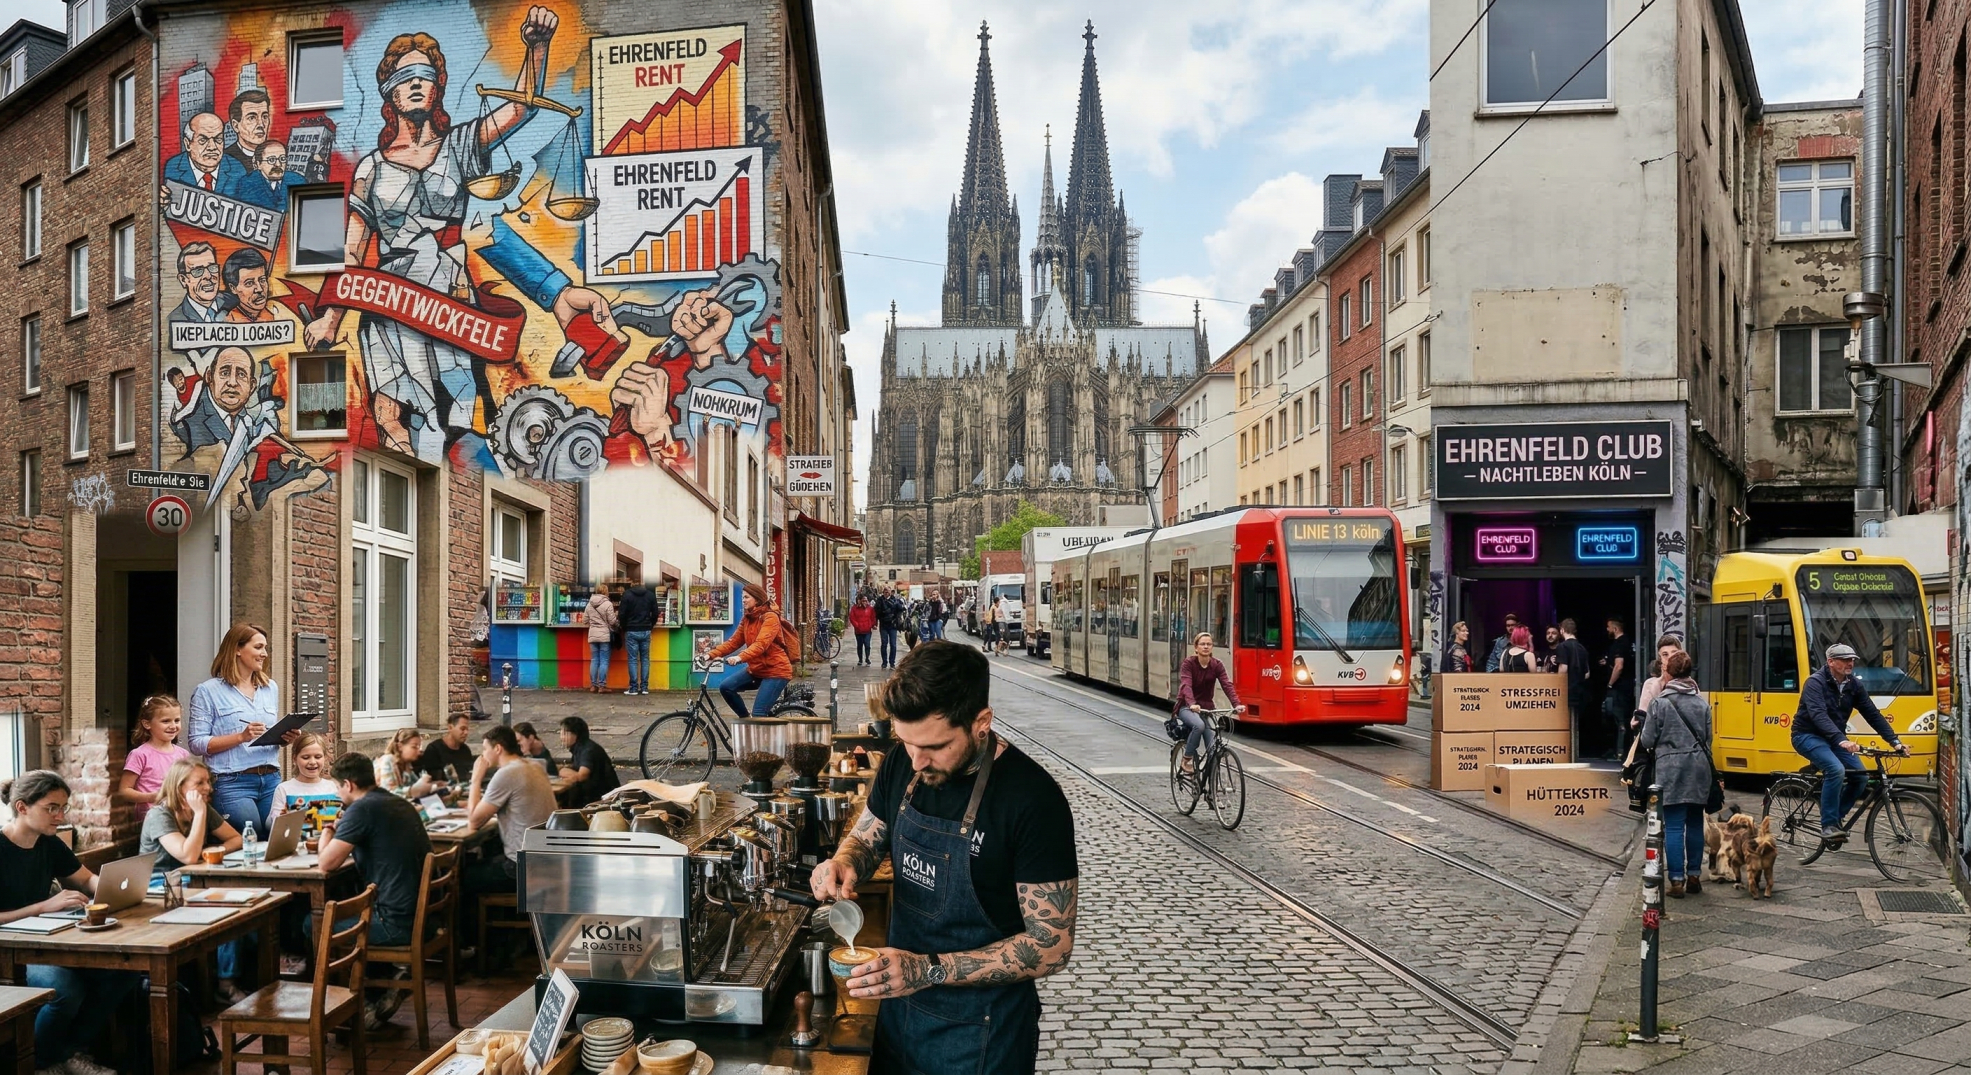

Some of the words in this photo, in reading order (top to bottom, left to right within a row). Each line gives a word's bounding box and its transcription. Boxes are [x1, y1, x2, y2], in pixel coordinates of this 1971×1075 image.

[609, 38, 707, 65] EHRENFELD
[635, 63, 686, 88] RENT
[614, 160, 717, 186] EHRENFELD
[637, 187, 685, 210] RENT
[170, 188, 273, 244] JUSTICE
[336, 273, 509, 353] GEGENTWICKFELE
[242, 324, 290, 340] LOGAIS?
[693, 392, 758, 419] NOHKRUM
[1445, 436, 1589, 464] EHRENFELD
[1597, 434, 1663, 460] CLUB
[1480, 465, 1584, 483] NACHTLEBEN
[1589, 461, 1631, 481] KÖLN
[157, 507, 183, 527] 30
[1294, 524, 1330, 540] LINIE
[1333, 524, 1347, 540] 13
[1352, 523, 1380, 540] köln
[1481, 535, 1531, 544] EHRENFELD
[1582, 534, 1633, 543] EHRENFELD
[1809, 572, 1821, 590] 5
[1338, 671, 1355, 679] KVB
[1501, 688, 1561, 697] STRESSFREI
[1505, 701, 1556, 709] UMZIEHEN
[1764, 716, 1780, 725] KVB
[1499, 746, 1567, 755] STRATEGISCH
[1458, 762, 1479, 770] 2024
[1526, 786, 1613, 801] HÜTTEKSTR.
[1554, 804, 1585, 816] 2024
[903, 852, 936, 879] KÖLN
[902, 866, 935, 888] ROASTERS
[581, 921, 642, 941] KÖLN
[582, 942, 643, 952] ROASTERS
